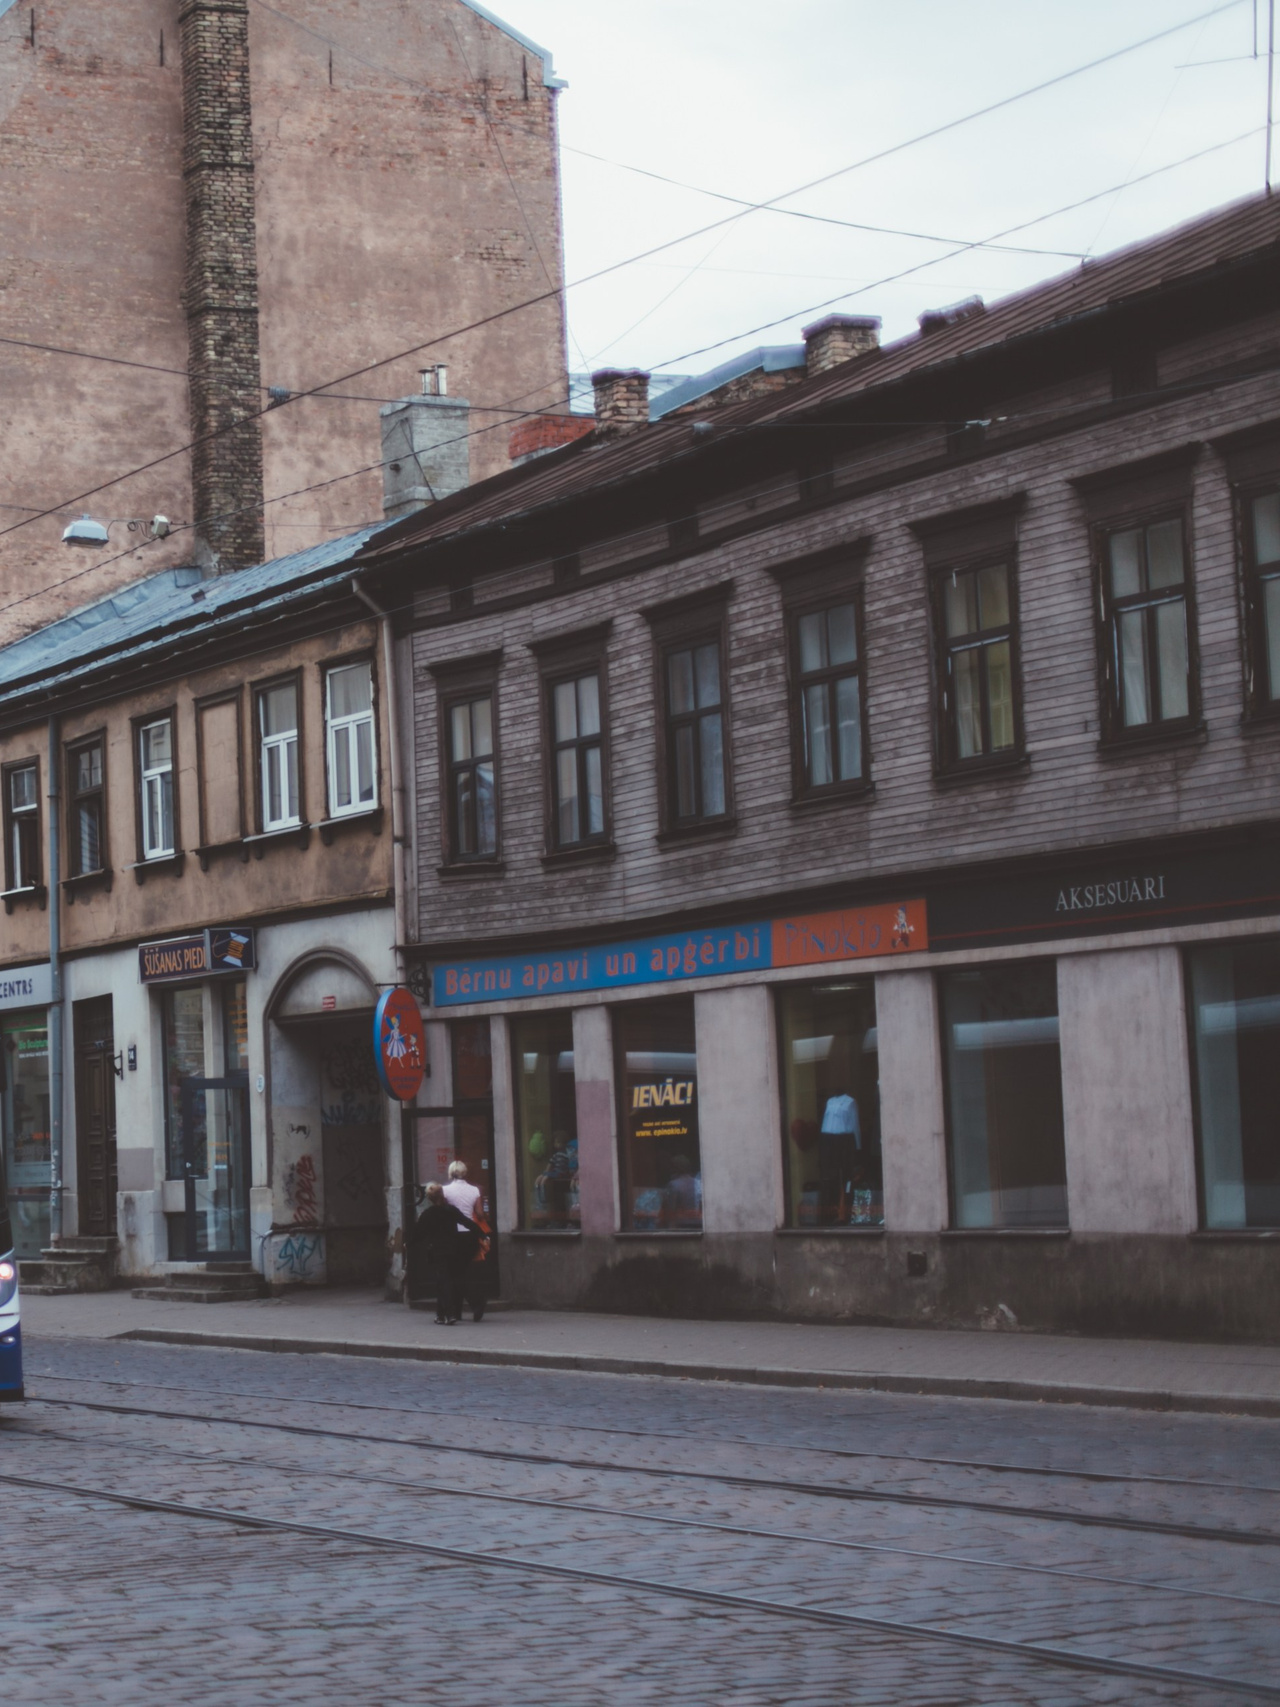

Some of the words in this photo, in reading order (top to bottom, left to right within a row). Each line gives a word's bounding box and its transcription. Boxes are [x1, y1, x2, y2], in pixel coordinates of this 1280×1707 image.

[1055, 875, 1166, 912] AKSESUĀRI
[446, 967, 511, 996] Bērnu
[522, 952, 588, 991] apavi
[606, 952, 636, 976] un
[651, 928, 760, 976] apģērbi
[632, 1078, 694, 1108] IENĀC!
